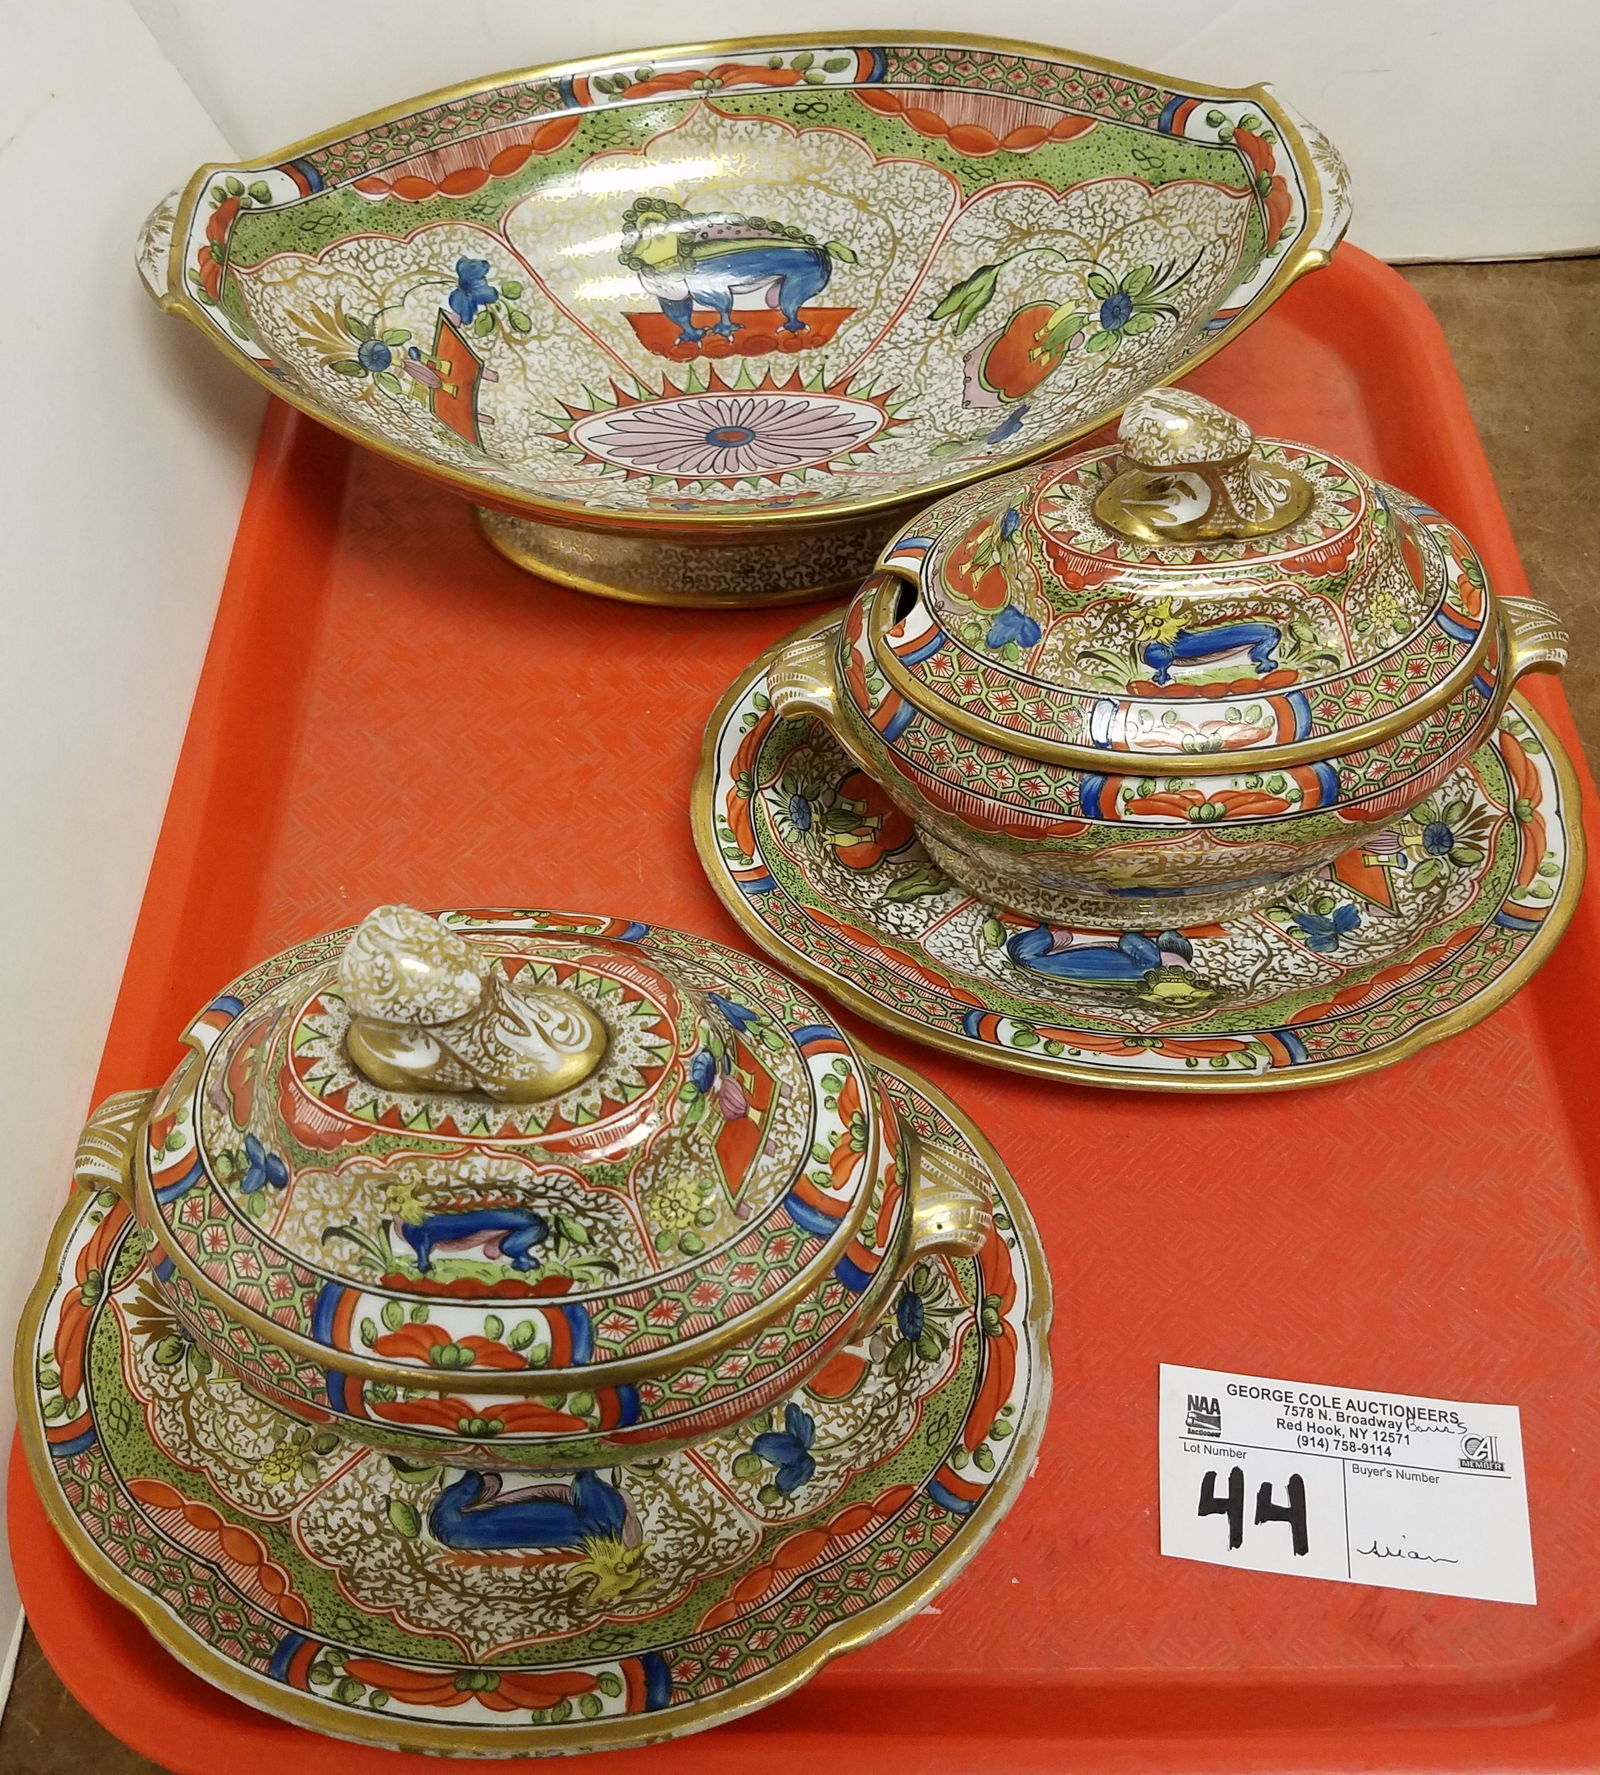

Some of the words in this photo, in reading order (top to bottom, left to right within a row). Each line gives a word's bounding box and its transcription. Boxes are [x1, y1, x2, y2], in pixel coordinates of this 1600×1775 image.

[1187, 1394, 1221, 1415] NAA
[1226, 1383, 1294, 1404] GEORGE
[1298, 1392, 1341, 1411] COLE
[1345, 1399, 1460, 1424] AUCTIONEERS
[1283, 1404, 1314, 1419] 7578
[1318, 1409, 1332, 1421] N.
[1336, 1412, 1403, 1432] Broadway
[1276, 1418, 1302, 1432] Red
[1306, 1421, 1346, 1439] Hook,
[1350, 1427, 1369, 1440] NY
[1372, 1430, 1410, 1446] 12571
[1183, 1442, 1201, 1454] Lot
[1203, 1445, 1248, 1460] Number
[1296, 1435, 1329, 1453] (914)
[1333, 1439, 1392, 1457] 758-9114
[1351, 1463, 1393, 1478] Buyer's
[1395, 1469, 1440, 1485] Number
[1459, 1459, 1504, 1471] MEMBER
[1197, 1465, 1309, 1557] 44
